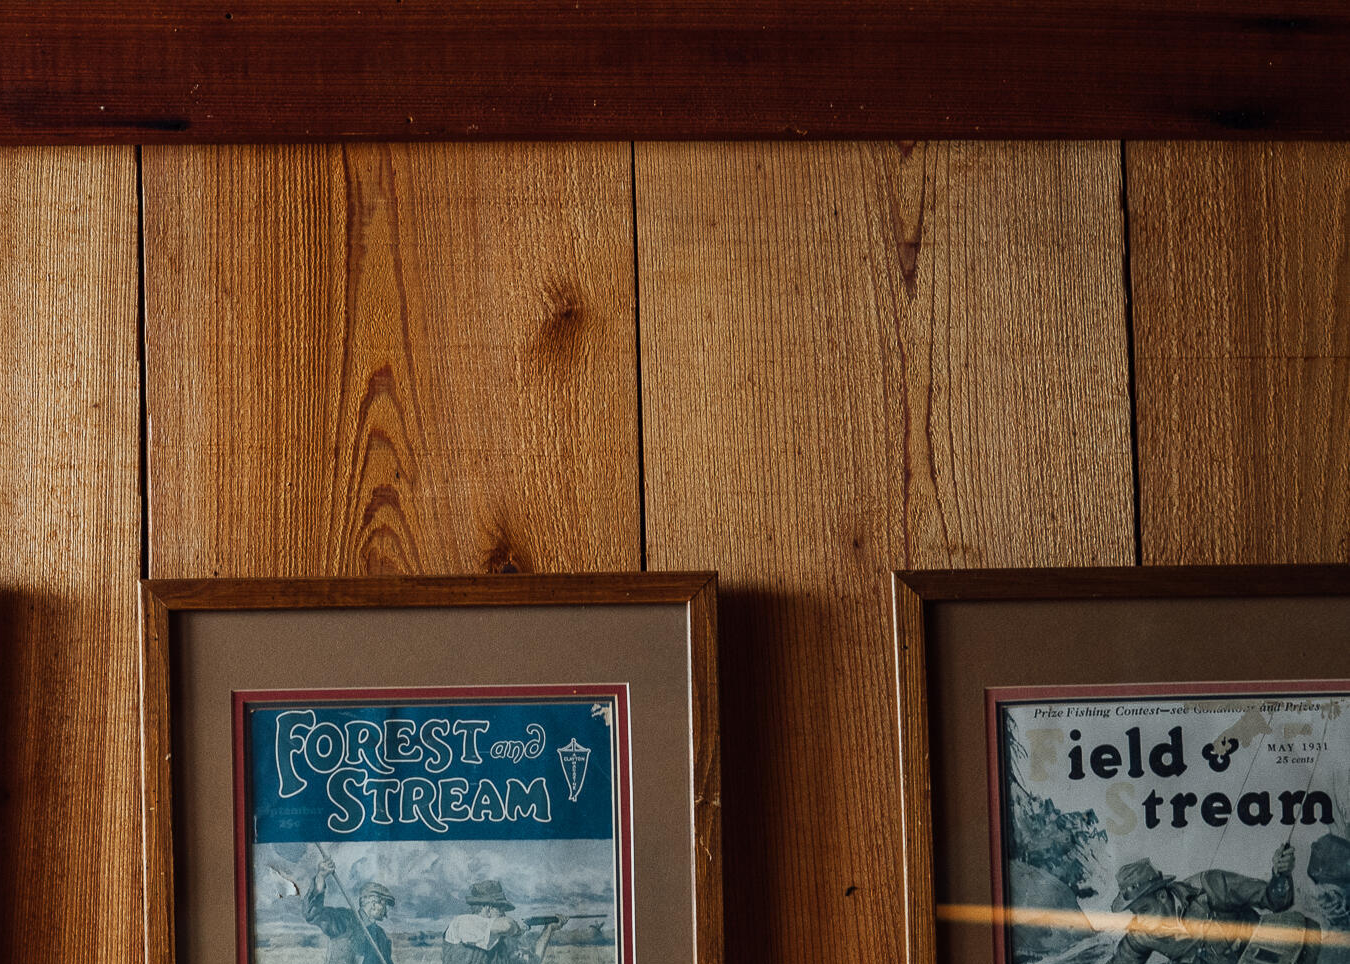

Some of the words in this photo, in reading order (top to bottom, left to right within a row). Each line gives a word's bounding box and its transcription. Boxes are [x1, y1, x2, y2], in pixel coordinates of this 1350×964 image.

[1033, 707, 1063, 718] Prize
[1066, 706, 1110, 718] Fishing
[1288, 701, 1321, 712] Prizes
[275, 710, 490, 798] FOREST
[490, 723, 546, 760] and
[1267, 743, 1295, 752] MAY
[1302, 742, 1329, 751] 1931
[1275, 756, 1289, 764] 25
[1291, 755, 1315, 764] cents
[327, 768, 551, 833] STREAM
